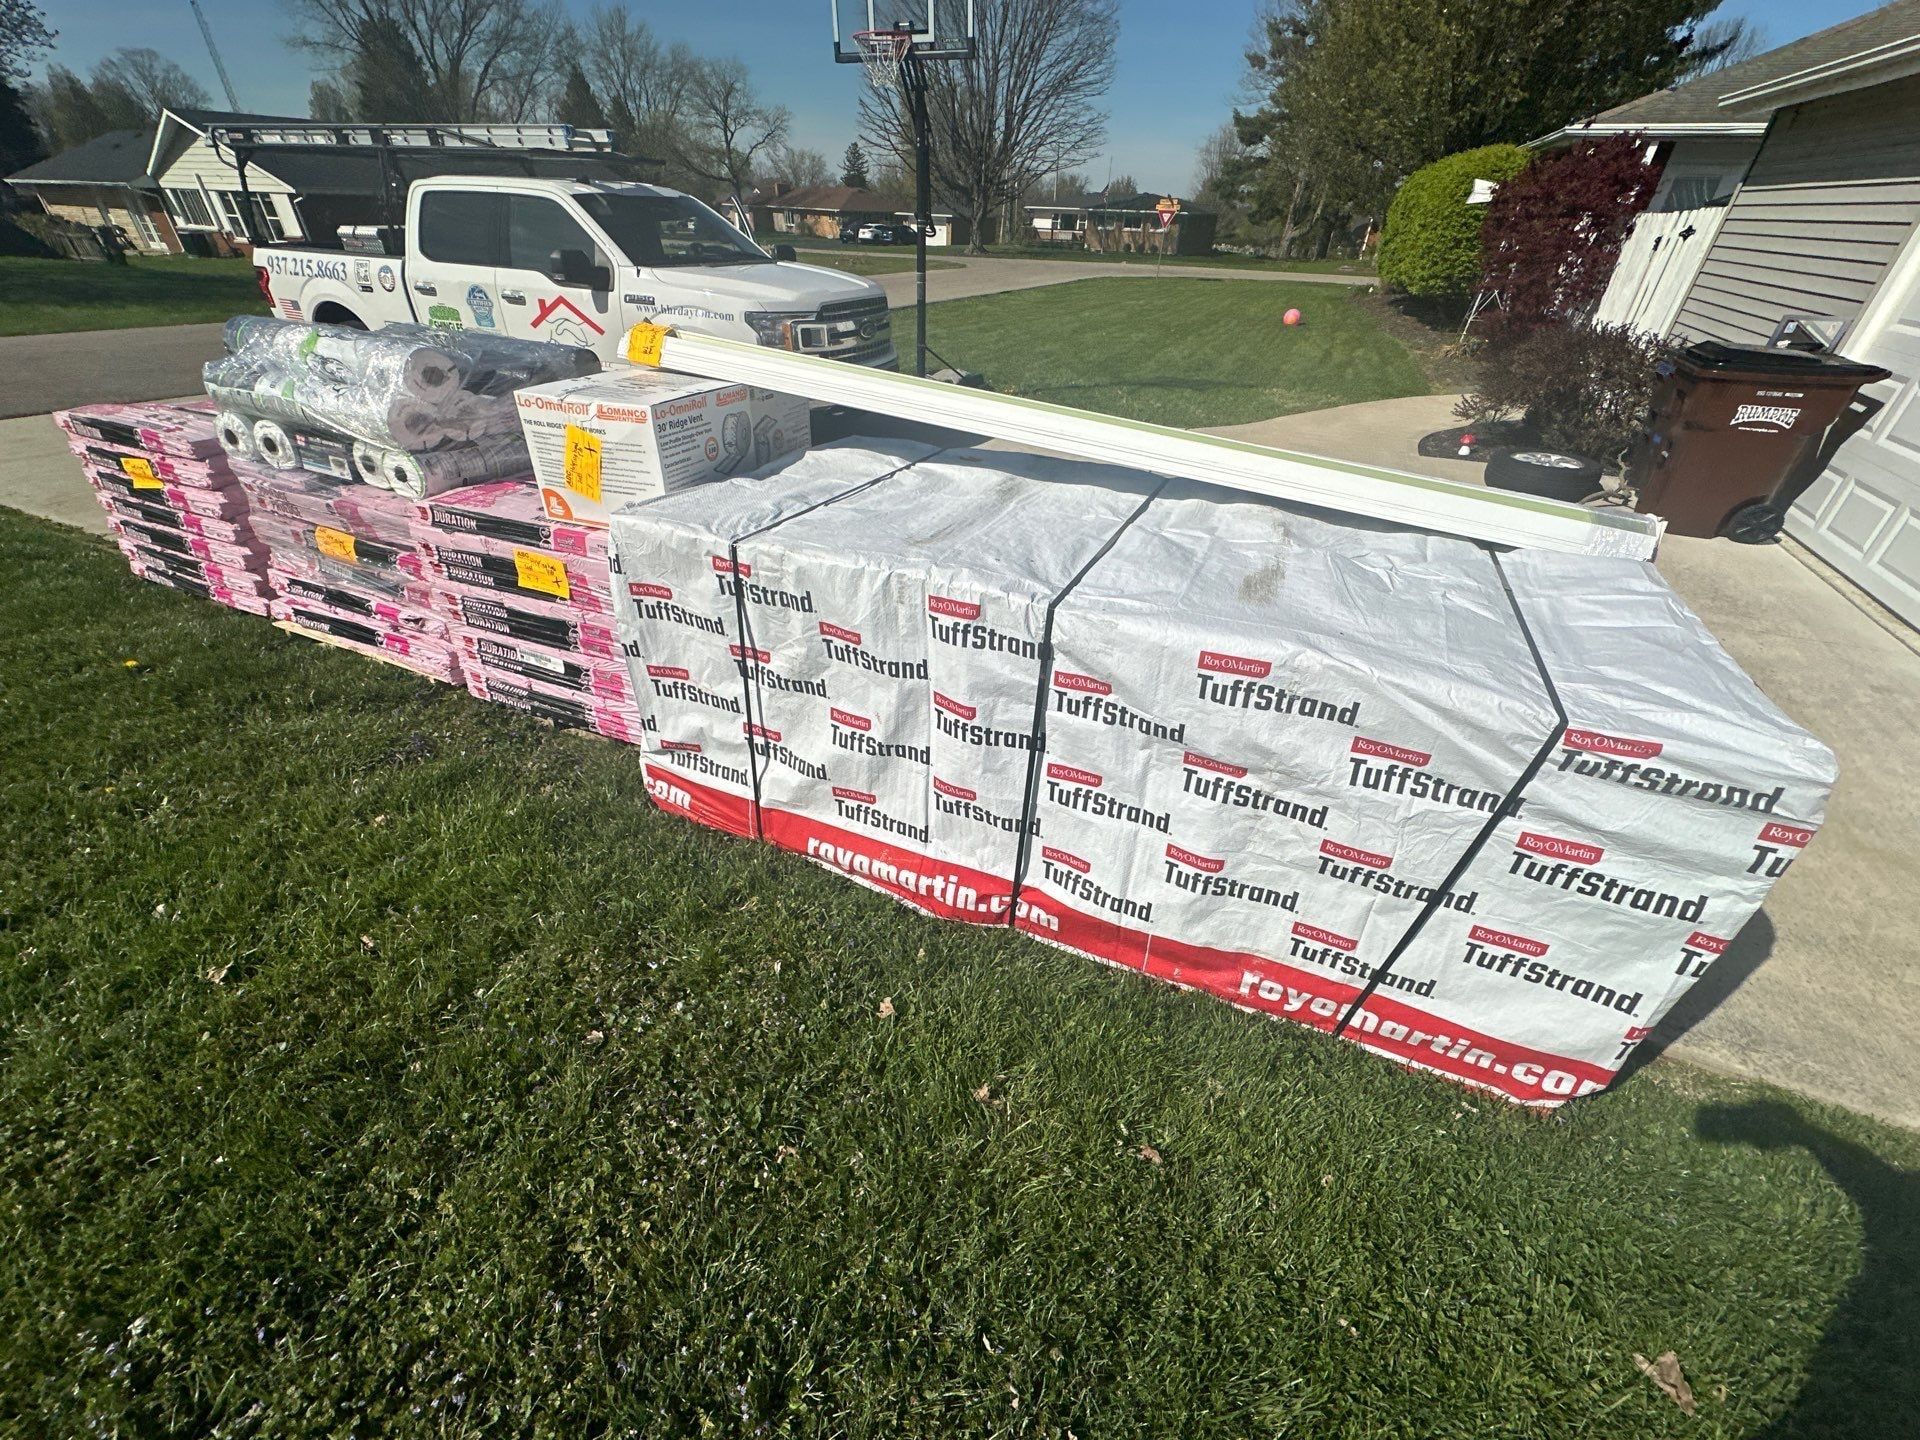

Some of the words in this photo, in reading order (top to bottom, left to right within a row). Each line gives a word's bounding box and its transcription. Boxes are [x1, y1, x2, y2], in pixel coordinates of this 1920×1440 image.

[267, 256, 347, 282] 937.215.8663
[517, 394, 589, 416] Lo-OmniRoll
[600, 403, 647, 418] LOMANCO
[669, 417, 688, 431] Ridge
[688, 413, 704, 424] Vent
[434, 510, 477, 530] DURATION
[633, 598, 725, 636] TuffStrand
[929, 598, 977, 617] RoyOMartin
[822, 624, 859, 643] RoyOMartin
[929, 614, 1051, 661] TuffStran
[822, 638, 929, 681] TuffStrand
[1203, 654, 1265, 676] RoyOMartin
[1058, 673, 1109, 693] RoyOMartin
[650, 679, 741, 714] TuffStrand
[935, 693, 973, 717] RoyOMartin
[1197, 672, 1361, 727] TuffStrand
[833, 710, 870, 729] RoyOMartin
[1054, 690, 1186, 744] TuffStrand
[831, 723, 930, 766] TuffStrand
[1357, 740, 1424, 764] RoyOMartin
[1050, 766, 1099, 785] RoyOMartin
[1556, 748, 1785, 814] TuffStrand
[935, 779, 975, 799] RoyOMartin
[1182, 767, 1330, 829] TuffStrand
[1046, 780, 1172, 835] TuffStrand
[834, 799, 930, 844] TuffStrand
[1045, 848, 1088, 871] RoyOMartin
[1169, 847, 1221, 869] RoyOMartin
[1325, 842, 1387, 866] RoyOMartin
[1523, 836, 1596, 860] RoyOMartin
[1042, 860, 1153, 923] TuffStrand
[1165, 860, 1300, 913] TuffStrand
[1508, 850, 1709, 923] TuffStrand
[1297, 925, 1353, 949] RoyOMartin
[1475, 928, 1542, 954] RoyOMartin
[1463, 941, 1644, 1017] TuffStrand
